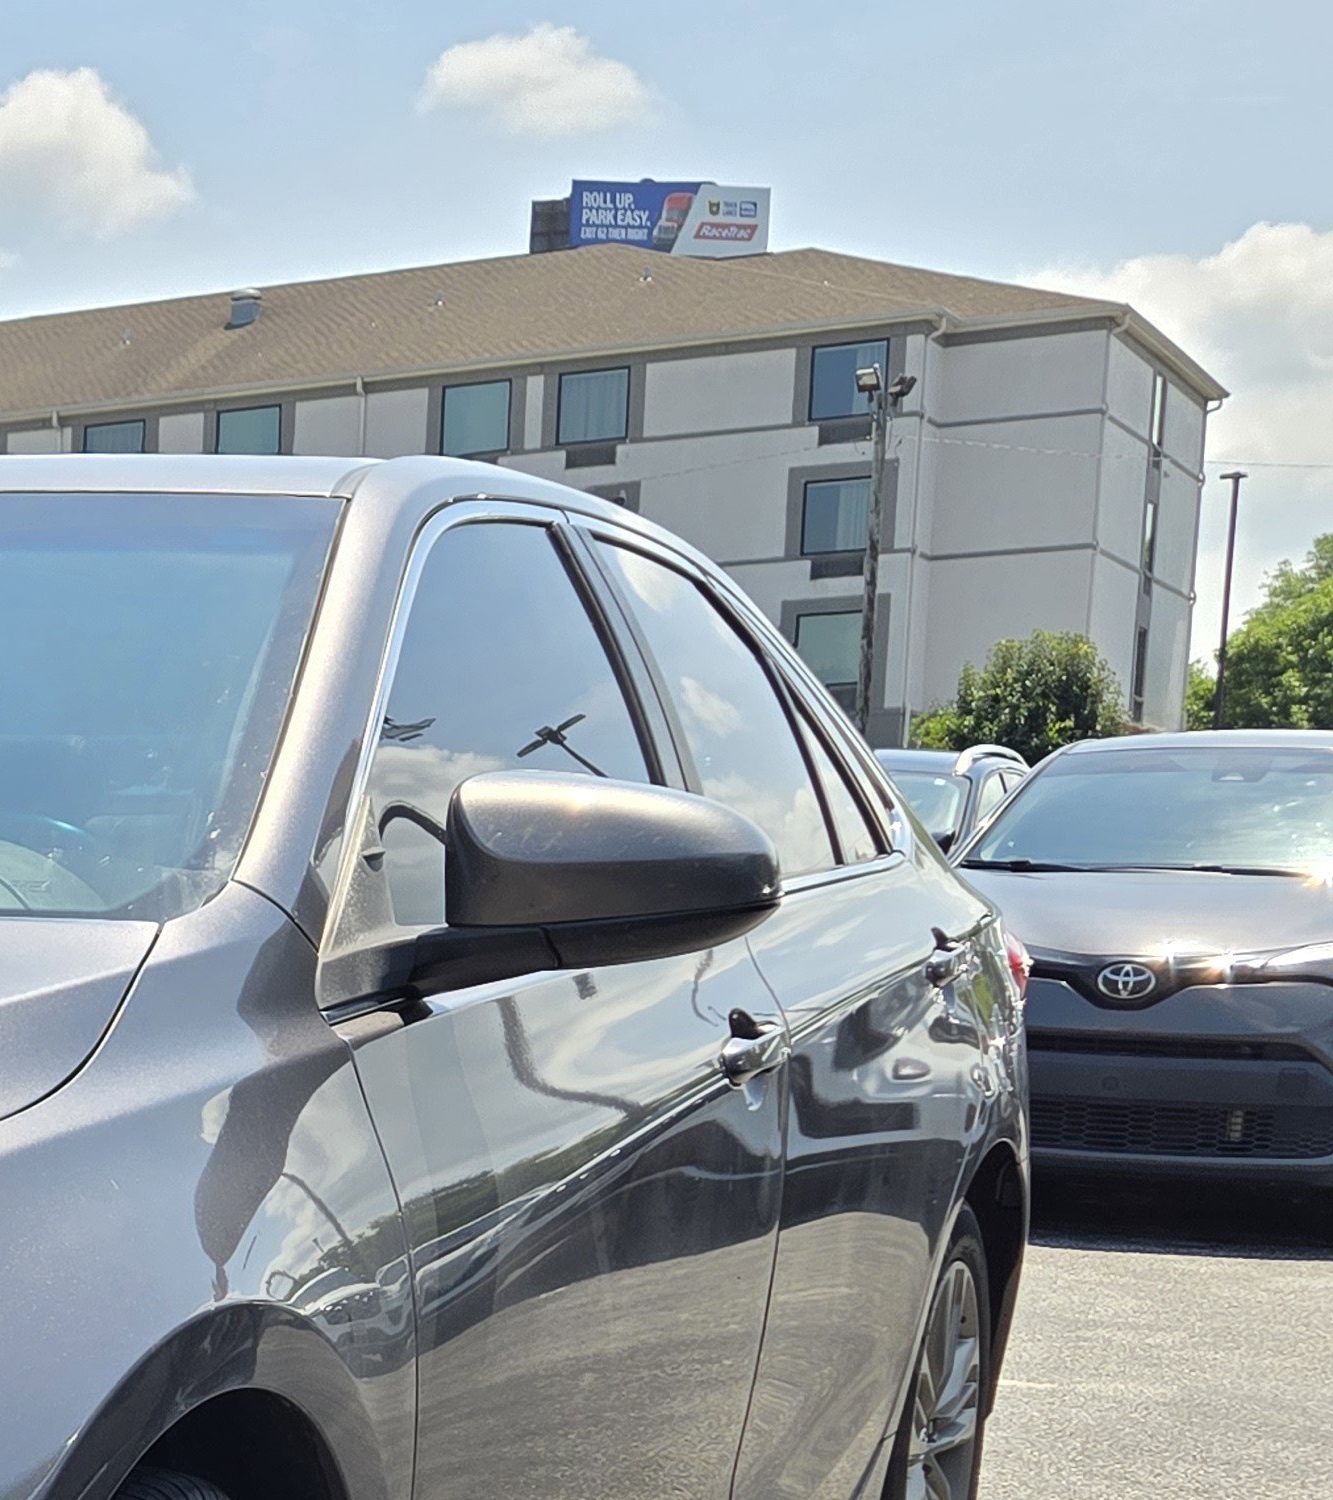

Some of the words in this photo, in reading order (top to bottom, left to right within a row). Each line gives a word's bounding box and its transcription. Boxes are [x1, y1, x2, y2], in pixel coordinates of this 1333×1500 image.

[582, 191, 614, 208] ROLL
[616, 192, 635, 209] UP.
[582, 208, 615, 225] PARK
[616, 209, 651, 227] EASY.
[699, 224, 752, 239] RaceTrac
